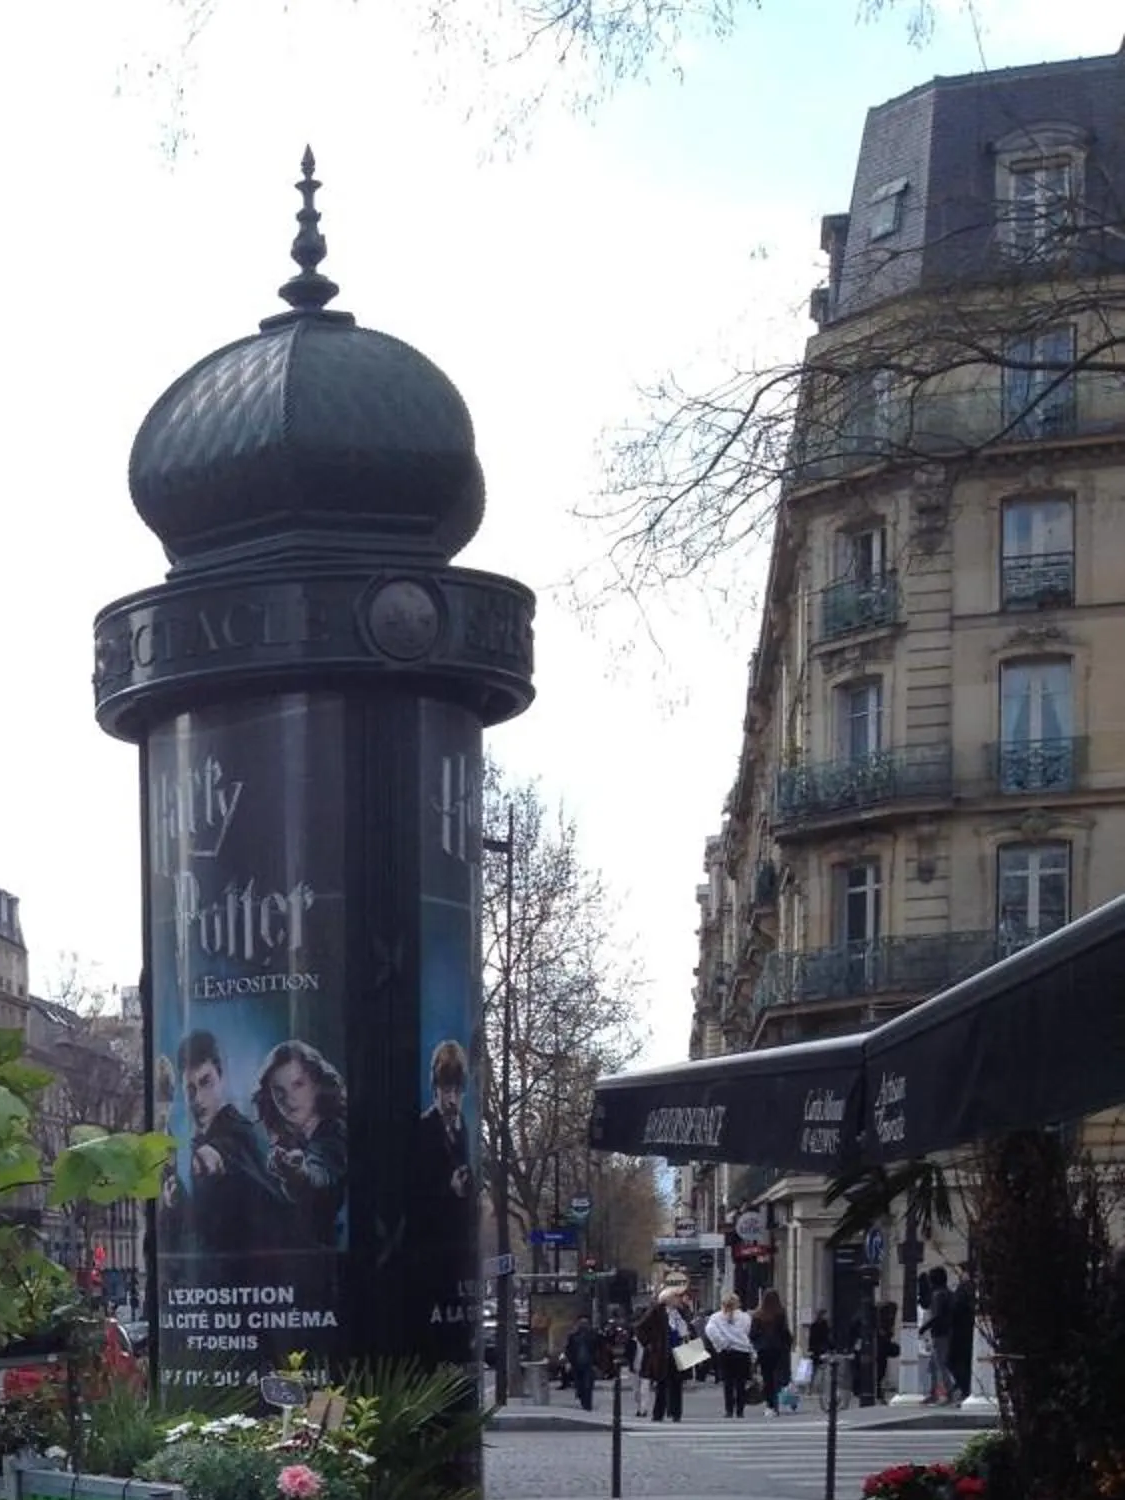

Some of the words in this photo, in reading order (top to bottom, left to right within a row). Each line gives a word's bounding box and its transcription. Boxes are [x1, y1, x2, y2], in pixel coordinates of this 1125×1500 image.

[174, 874, 315, 972] Potter
[168, 1285, 295, 1306] L'EXPOSITION
[175, 1309, 211, 1330] CITÉ
[213, 1312, 242, 1330] DU
[247, 1307, 339, 1330] CINÉMA
